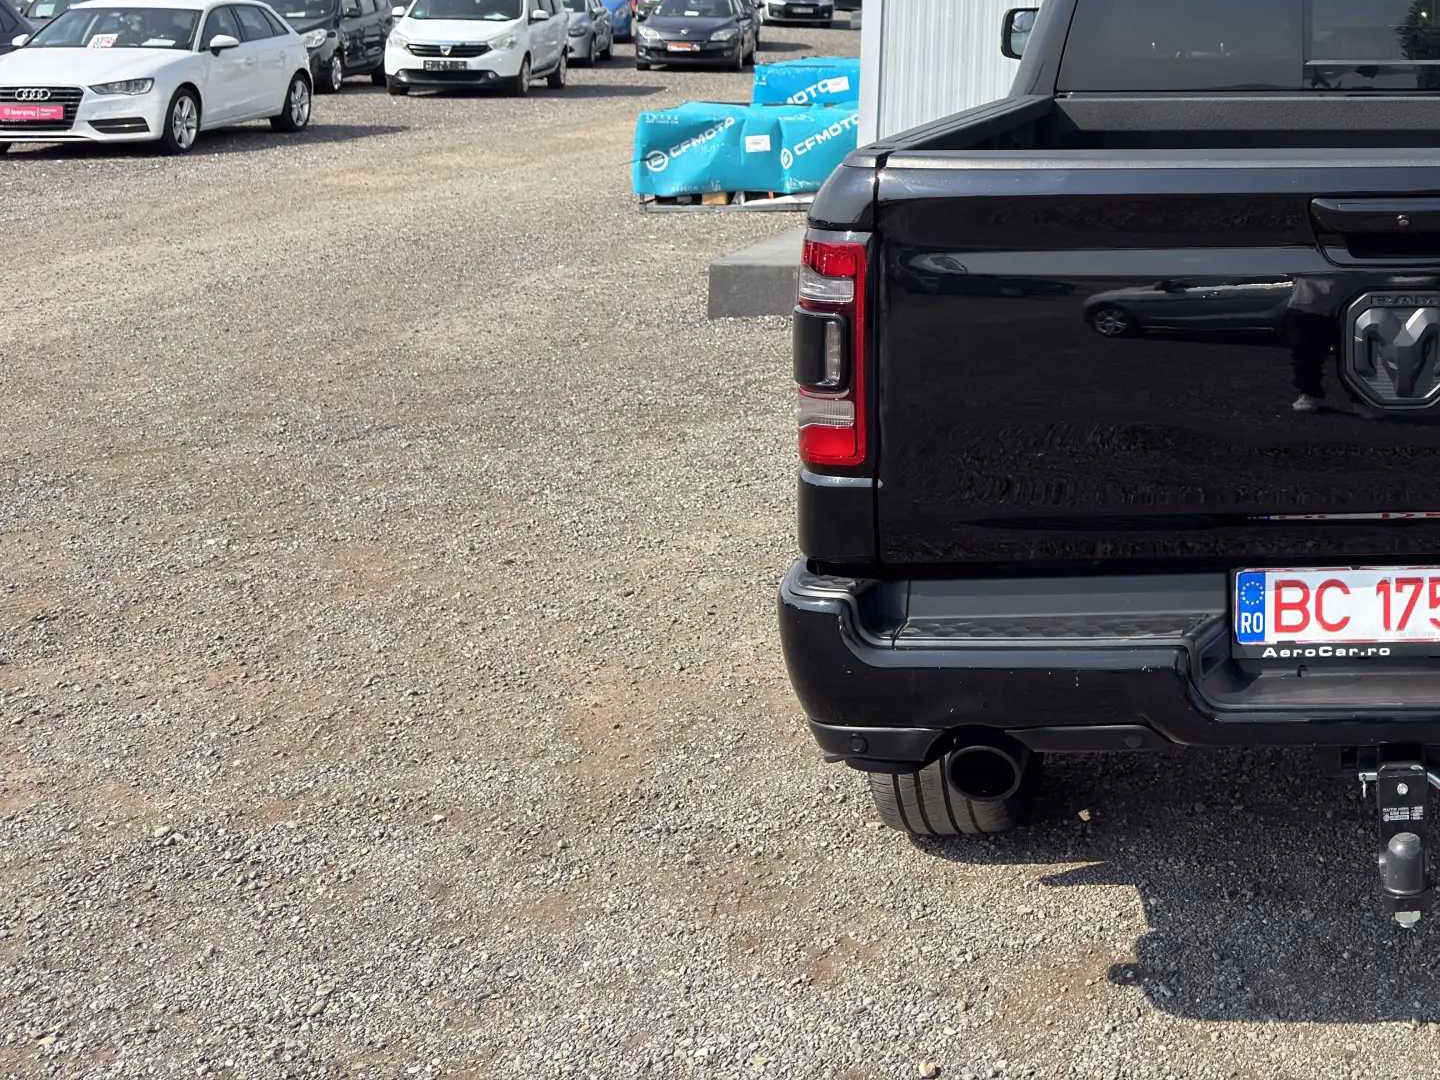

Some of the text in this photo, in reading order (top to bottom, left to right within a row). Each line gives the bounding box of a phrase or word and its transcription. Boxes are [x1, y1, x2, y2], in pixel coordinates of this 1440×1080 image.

[669, 116, 736, 158] CFMOTO
[793, 113, 859, 156] CFMOTO
[1241, 612, 1264, 634] RO
[1273, 578, 1352, 633] BC
[1262, 645, 1391, 659] AeroCar.ro
